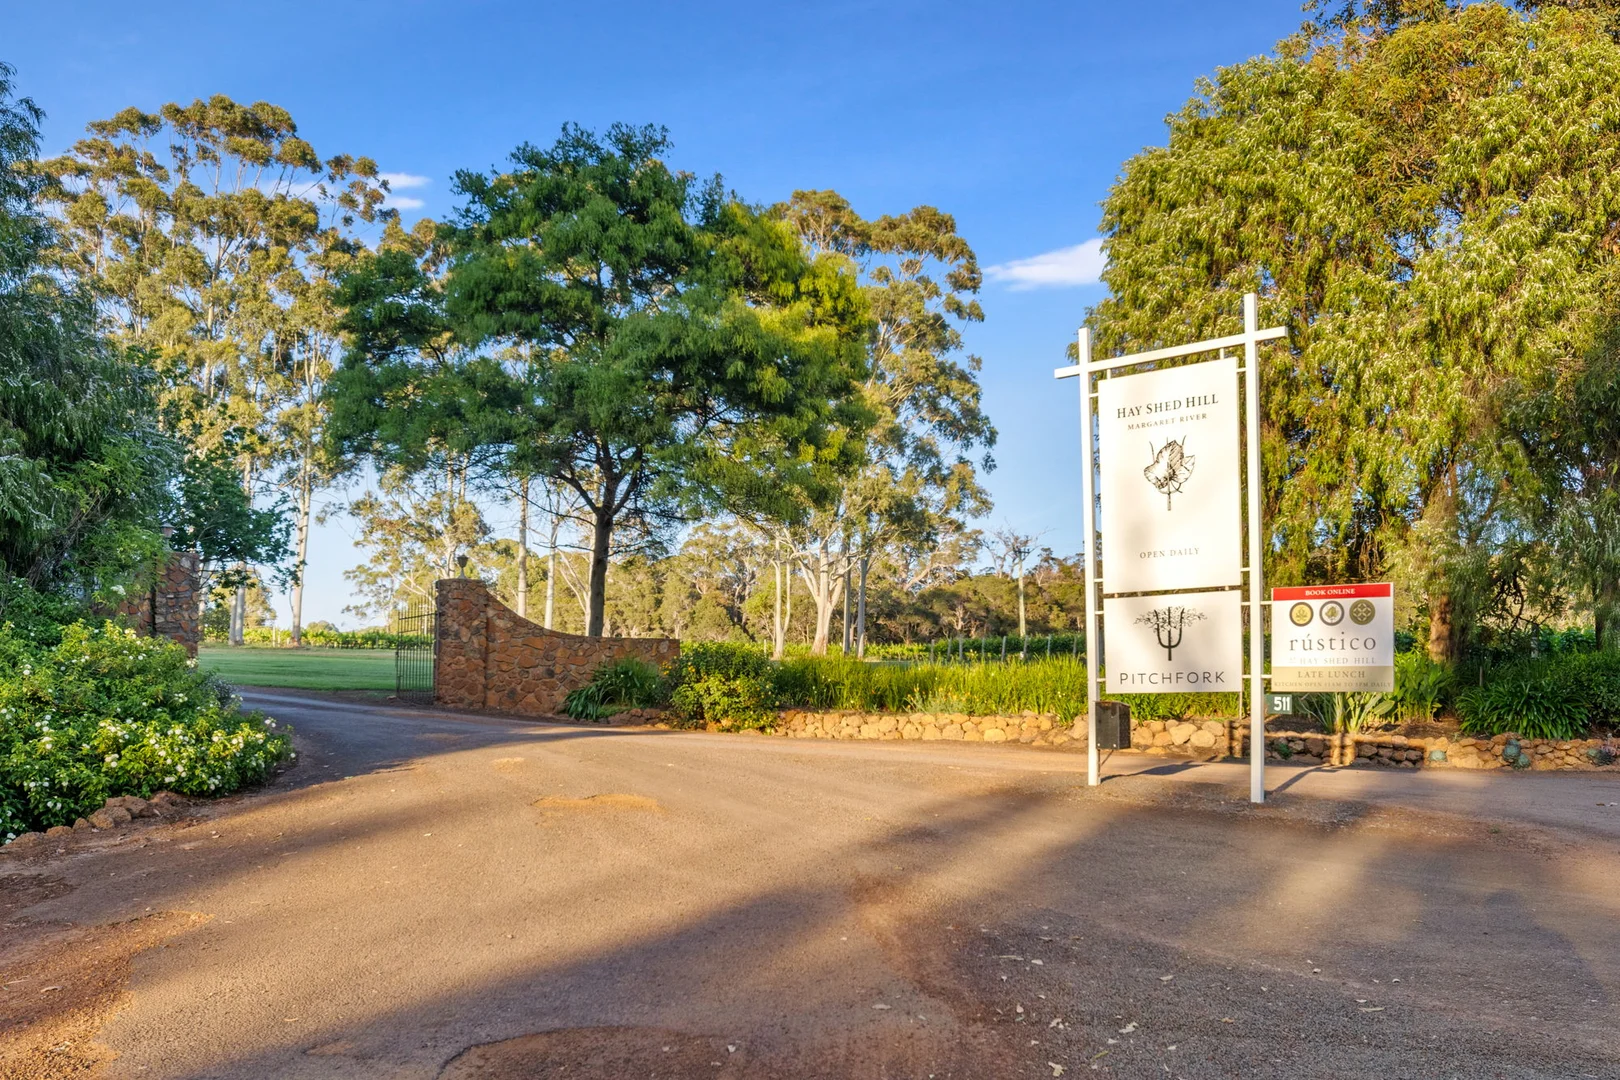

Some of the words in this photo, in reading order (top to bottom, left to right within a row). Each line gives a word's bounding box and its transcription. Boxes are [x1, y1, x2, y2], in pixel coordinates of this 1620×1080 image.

[1117, 405, 1142, 418] HAY
[1146, 400, 1182, 414] SHED
[1186, 394, 1219, 408] HILL
[1127, 417, 1176, 430] MARGARET
[1180, 413, 1207, 423] RIVER
[1139, 550, 1165, 559] OPEN
[1170, 547, 1199, 557] DAILY
[1289, 631, 1376, 651] rústico
[1300, 657, 1318, 665] HAY
[1324, 657, 1348, 665] SHED
[1354, 657, 1376, 665] HILL
[1119, 671, 1225, 685] PITCHFORK
[1298, 670, 1323, 678] LATE
[1328, 670, 1365, 679] LUNCH
[1273, 696, 1290, 711] 511
